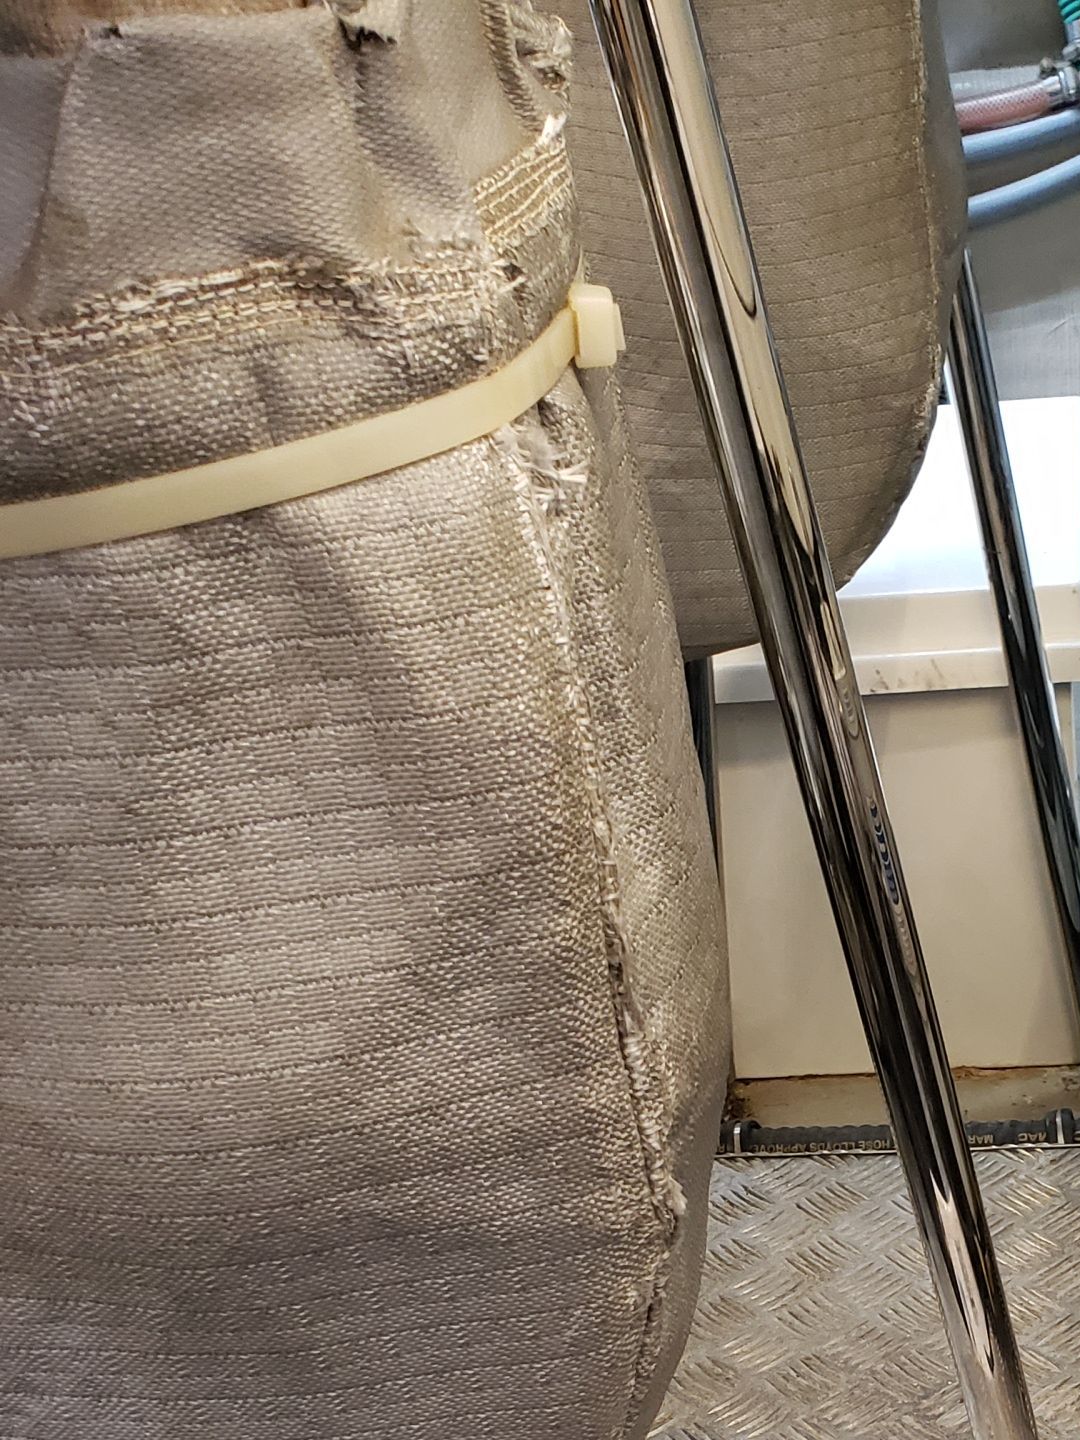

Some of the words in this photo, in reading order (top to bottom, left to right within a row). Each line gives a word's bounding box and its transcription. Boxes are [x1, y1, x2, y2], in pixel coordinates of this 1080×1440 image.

[752, 1143, 807, 1153] APPROVE
[810, 1141, 856, 1151] LLOYDS
[859, 1139, 890, 1150] HOSE
